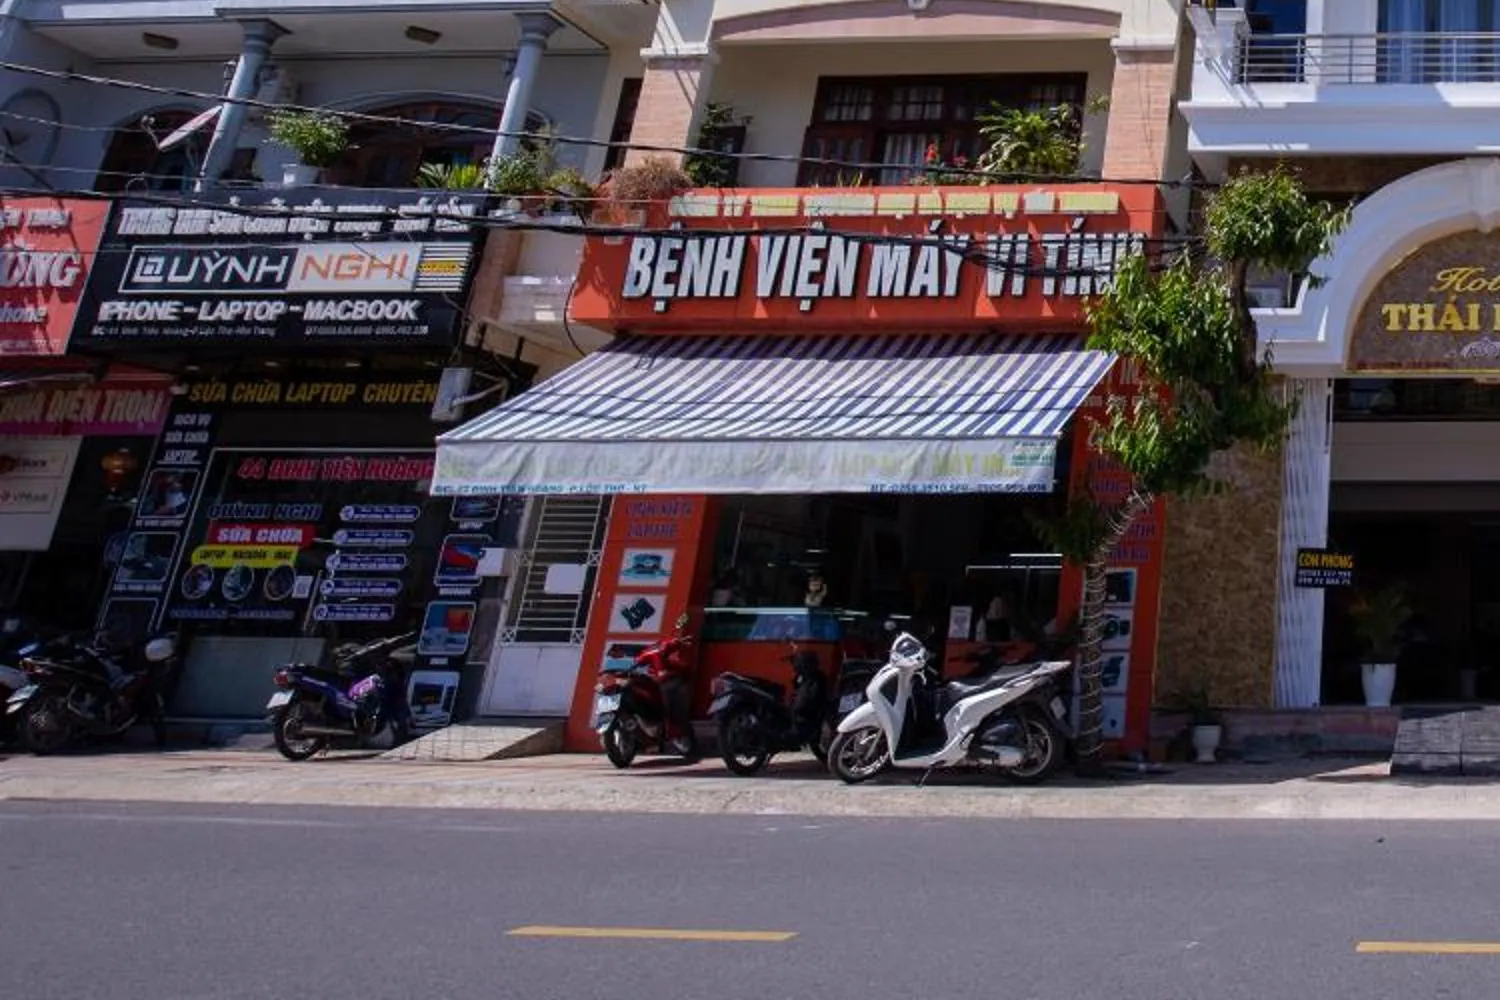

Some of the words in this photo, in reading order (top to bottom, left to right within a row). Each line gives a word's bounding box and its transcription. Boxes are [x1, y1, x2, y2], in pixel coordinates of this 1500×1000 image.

[300, 252, 409, 281] NGHI
[622, 221, 746, 312] BỆNH
[756, 220, 860, 312] VIỆN
[866, 219, 971, 297] MÁY
[986, 233, 1030, 297] VI
[98, 301, 181, 321] IPHONE
[198, 301, 285, 321] LAPTOP
[303, 300, 420, 321] MACBOOK
[1382, 295, 1481, 332] THÁI
[285, 382, 356, 403] LAPTOP
